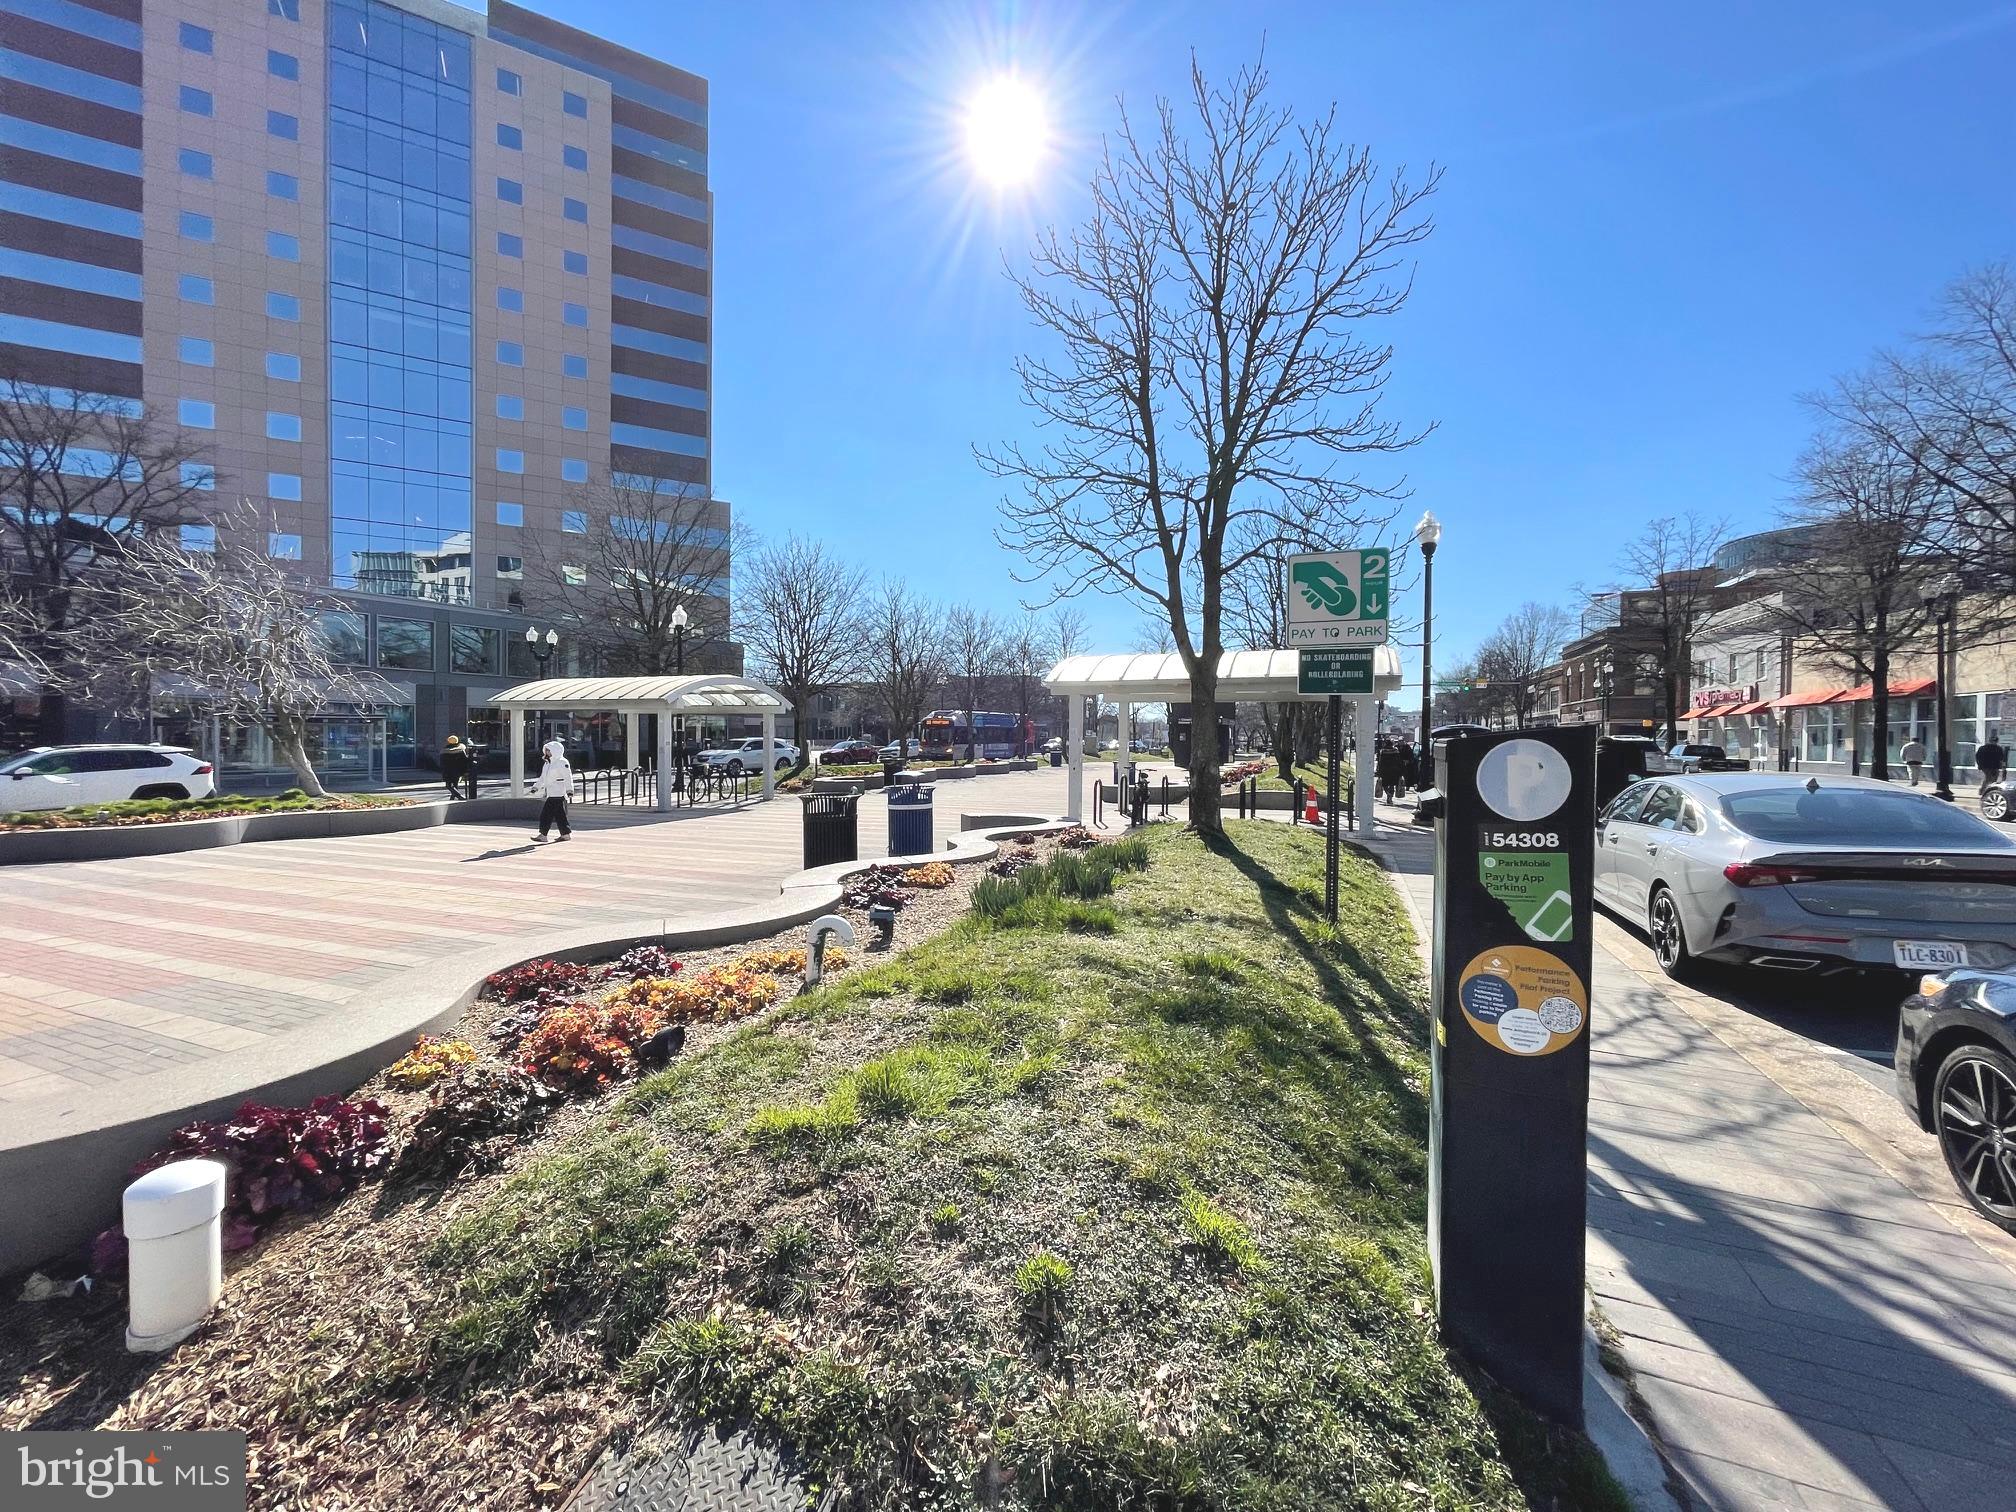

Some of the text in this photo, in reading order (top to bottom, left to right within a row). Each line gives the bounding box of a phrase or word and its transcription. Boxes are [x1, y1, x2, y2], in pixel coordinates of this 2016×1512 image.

[1363, 555, 1386, 579] 2
[1291, 625, 1383, 640] PAY TO PARK
[1301, 653, 1372, 662] NO SKATEBOARDING
[1331, 662, 1341, 670] OR
[1506, 753, 1546, 808] P
[1492, 832, 1560, 848] 54308
[1498, 859, 1551, 868] ParkMobile
[1485, 872, 1545, 884] Pay by App
[1486, 883, 1527, 893] Parking
[1515, 964, 1570, 976] Performance
[1538, 976, 1570, 988] Parking
[1520, 983, 1570, 995] Pilot Project
